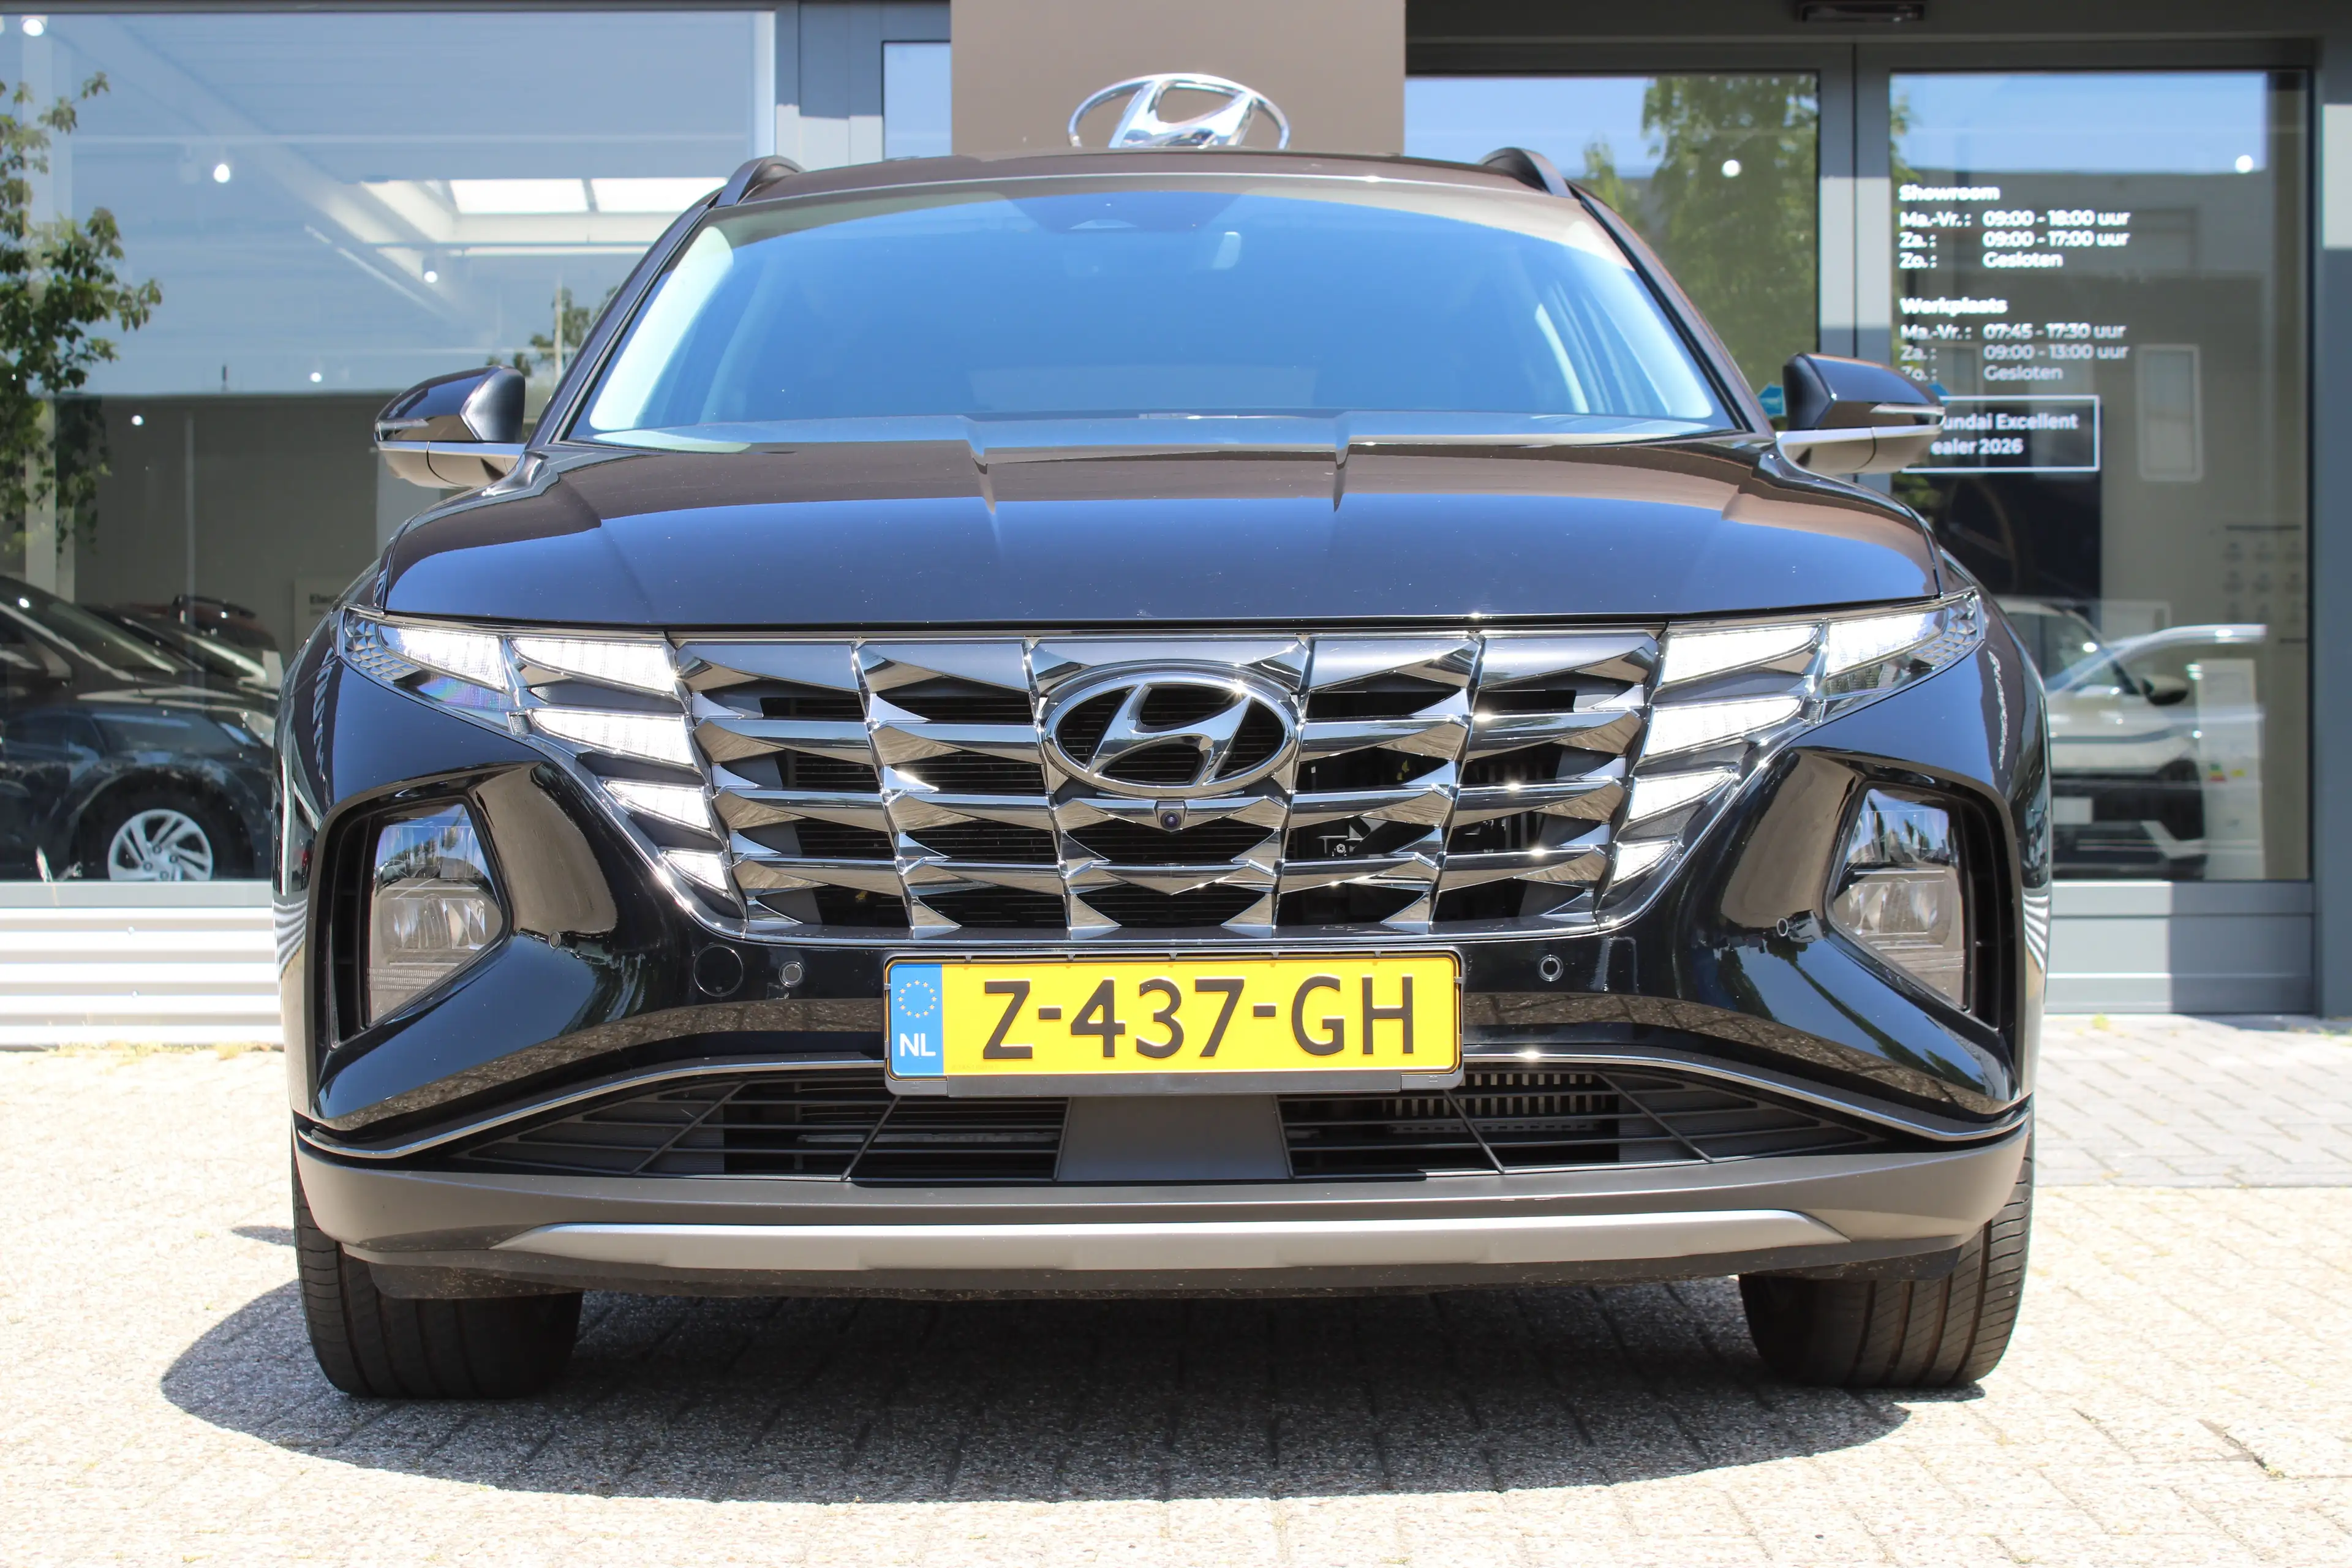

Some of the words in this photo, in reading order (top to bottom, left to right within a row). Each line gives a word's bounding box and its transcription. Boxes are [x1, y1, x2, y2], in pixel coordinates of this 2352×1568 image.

[1899, 184, 2001, 202] Showroom
[1983, 210, 2035, 227] 09:00
[2048, 210, 2095, 226] 18:00
[2097, 213, 2130, 225] uur
[1983, 231, 2035, 247] 09:00
[2048, 230, 2095, 247] 17:00
[2097, 233, 2130, 246] uur
[1983, 251, 2063, 268] Gesloten
[1899, 296, 2008, 317] Werkplaats
[1983, 323, 2033, 339] 07:45
[2046, 323, 2090, 339] 17:30
[2094, 326, 2126, 338] uur
[1983, 345, 2035, 360] 09:00
[2049, 344, 2095, 359] 13:00
[2097, 347, 2129, 360] uur
[1983, 365, 2063, 380] Gesloten
[1944, 414, 1993, 430] undai
[1996, 413, 2079, 430] Excellent
[1931, 438, 1977, 454] ealer
[1979, 439, 2024, 454] 2026
[983, 976, 1414, 1060] Z-437-GH
[899, 1033, 937, 1057] NL
